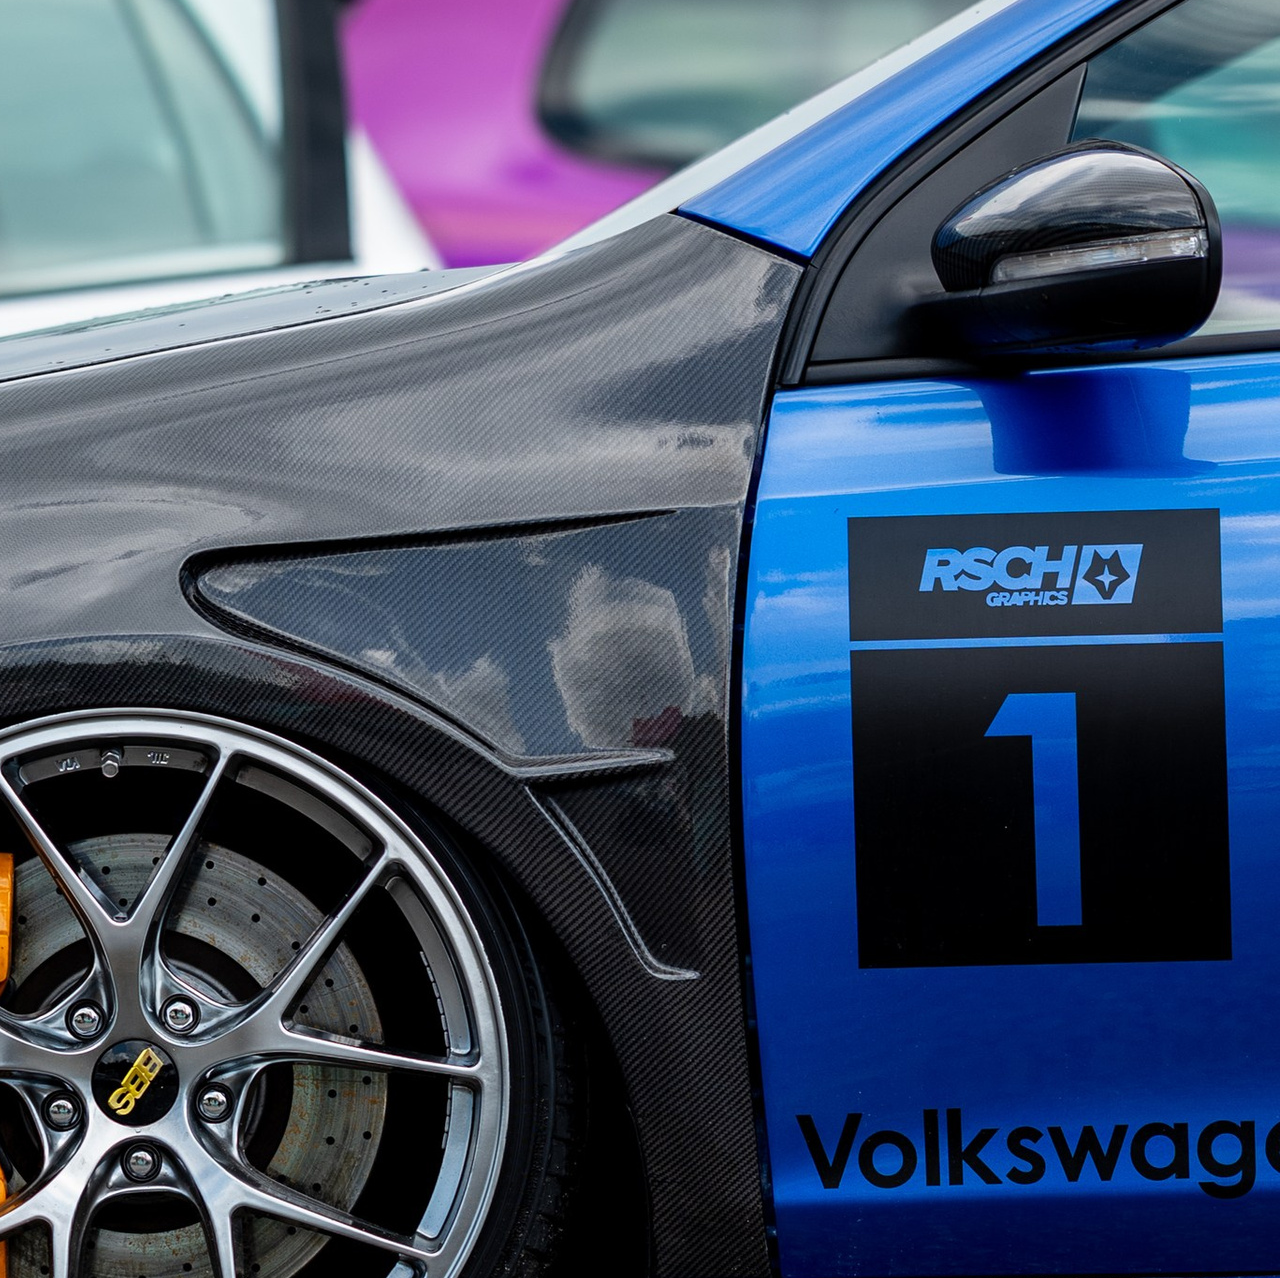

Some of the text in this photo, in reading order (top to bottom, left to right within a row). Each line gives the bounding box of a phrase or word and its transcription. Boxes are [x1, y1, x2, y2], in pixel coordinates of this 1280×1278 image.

[918, 545, 1078, 592] RSCH
[985, 590, 1069, 607] GRAPHICS
[983, 691, 1083, 927] 1
[107, 1047, 164, 1116] BBS
[795, 1107, 1280, 1200] Volkswag
